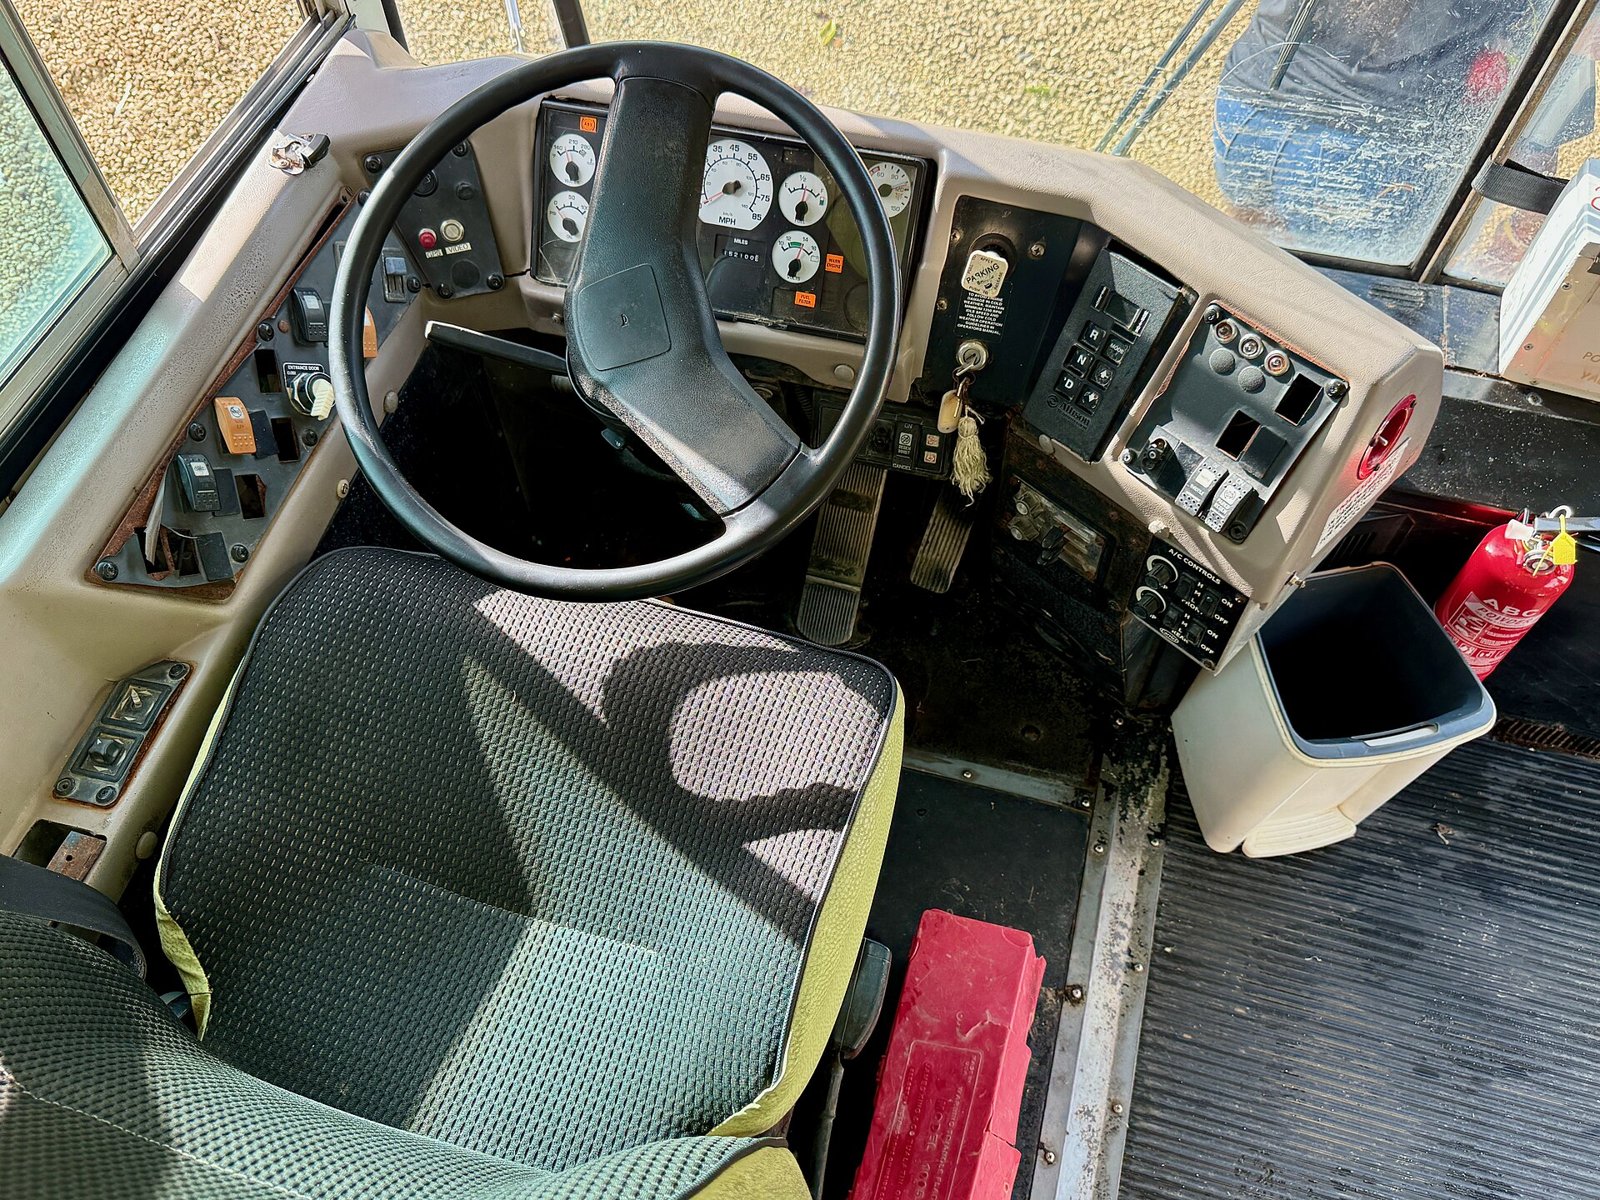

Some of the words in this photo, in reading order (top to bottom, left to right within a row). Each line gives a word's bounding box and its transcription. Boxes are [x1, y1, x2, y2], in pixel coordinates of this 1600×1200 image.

[730, 144, 740, 152] 45
[748, 152, 758, 160] 55
[760, 174, 770, 182] 65
[718, 216, 736, 226] MPH
[448, 244, 468, 252] VIDEO
[966, 263, 999, 284] PARKING
[1089, 330, 1099, 340] R
[1110, 342, 1124, 354] MODE
[1076, 354, 1087, 366] N
[1065, 378, 1074, 390] D
[1059, 402, 1091, 426] Allison
[1168, 548, 1183, 559] A/C
[1183, 558, 1221, 585] CONTROLS
[1221, 598, 1233, 608] ON
[1483, 598, 1540, 617] ABC
[1214, 614, 1229, 625] OFF
[1207, 629, 1218, 639] ON
[1200, 643, 1214, 654] OFF
[913, 1093, 924, 1114] KING
[947, 1085, 964, 1127] WARNING
[926, 1100, 948, 1152] MODEL
